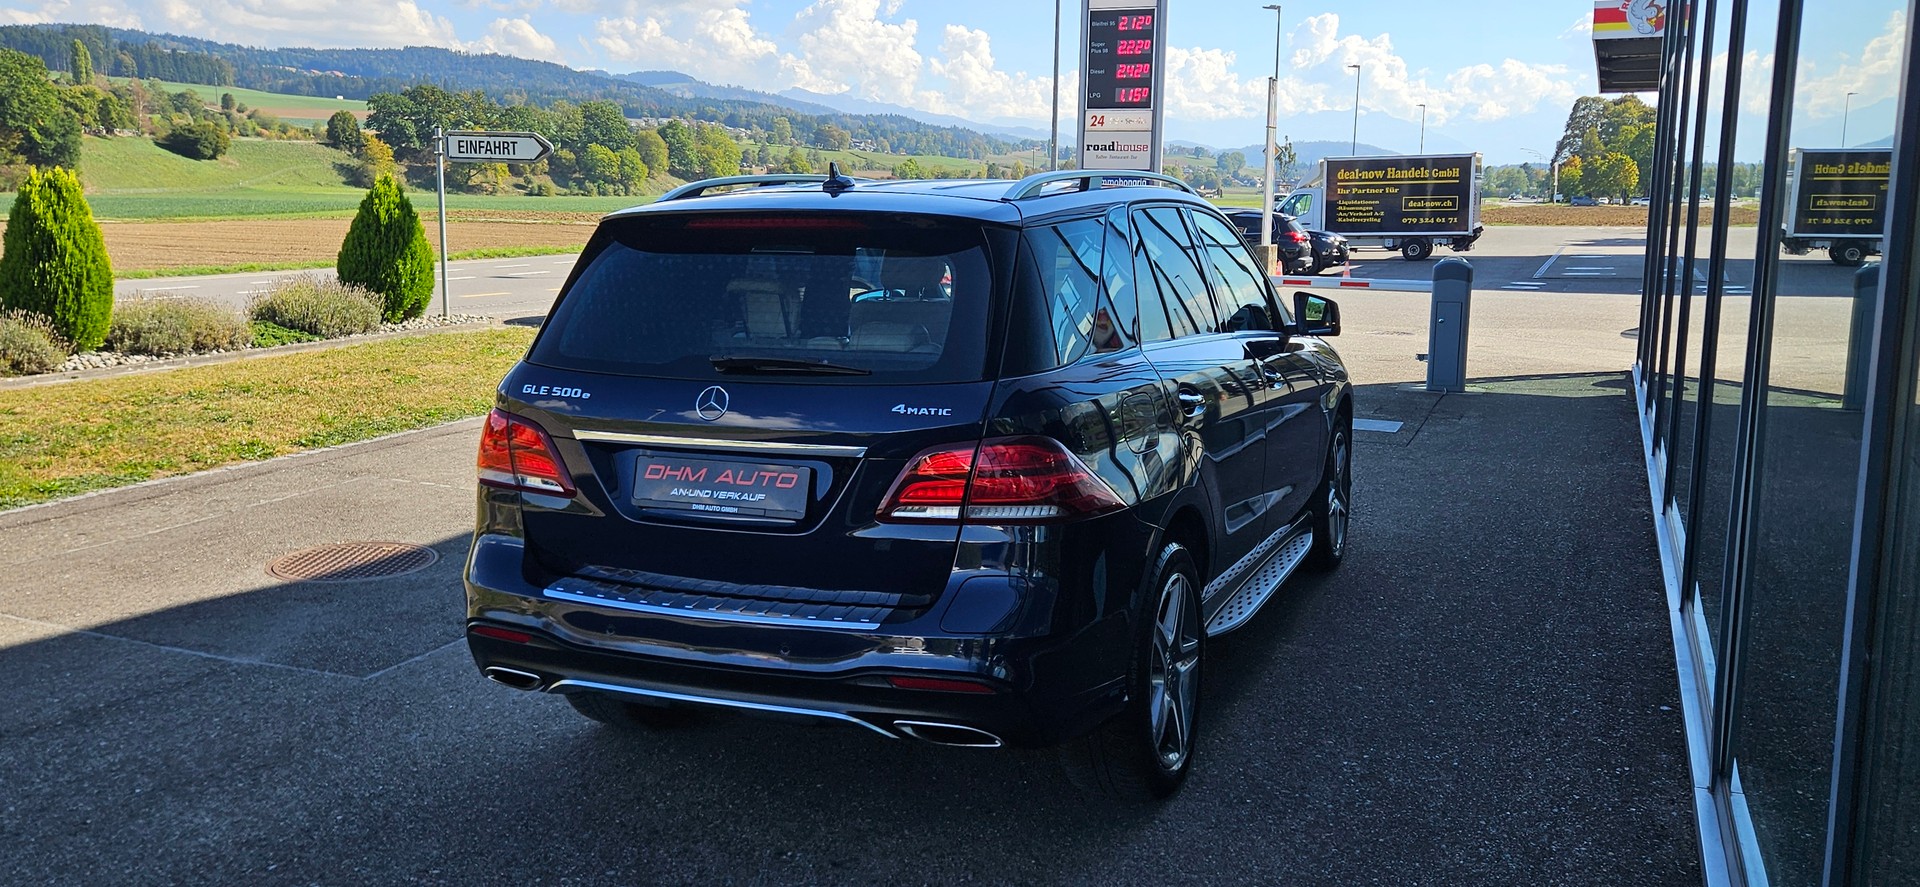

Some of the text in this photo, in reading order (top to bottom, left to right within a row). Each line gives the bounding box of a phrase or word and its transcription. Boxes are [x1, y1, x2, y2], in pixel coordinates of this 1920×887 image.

[1090, 115, 1105, 127] 24
[457, 140, 518, 155] EINFAHRT
[1086, 140, 1149, 152] roadhouse
[1386, 167, 1430, 178] Handels
[1431, 167, 1460, 178] GmbH
[522, 384, 591, 399] GLE 500e
[891, 403, 952, 416] 4MATIC
[644, 464, 799, 488] DHM AUTO
[713, 491, 766, 501] VERKAUF
